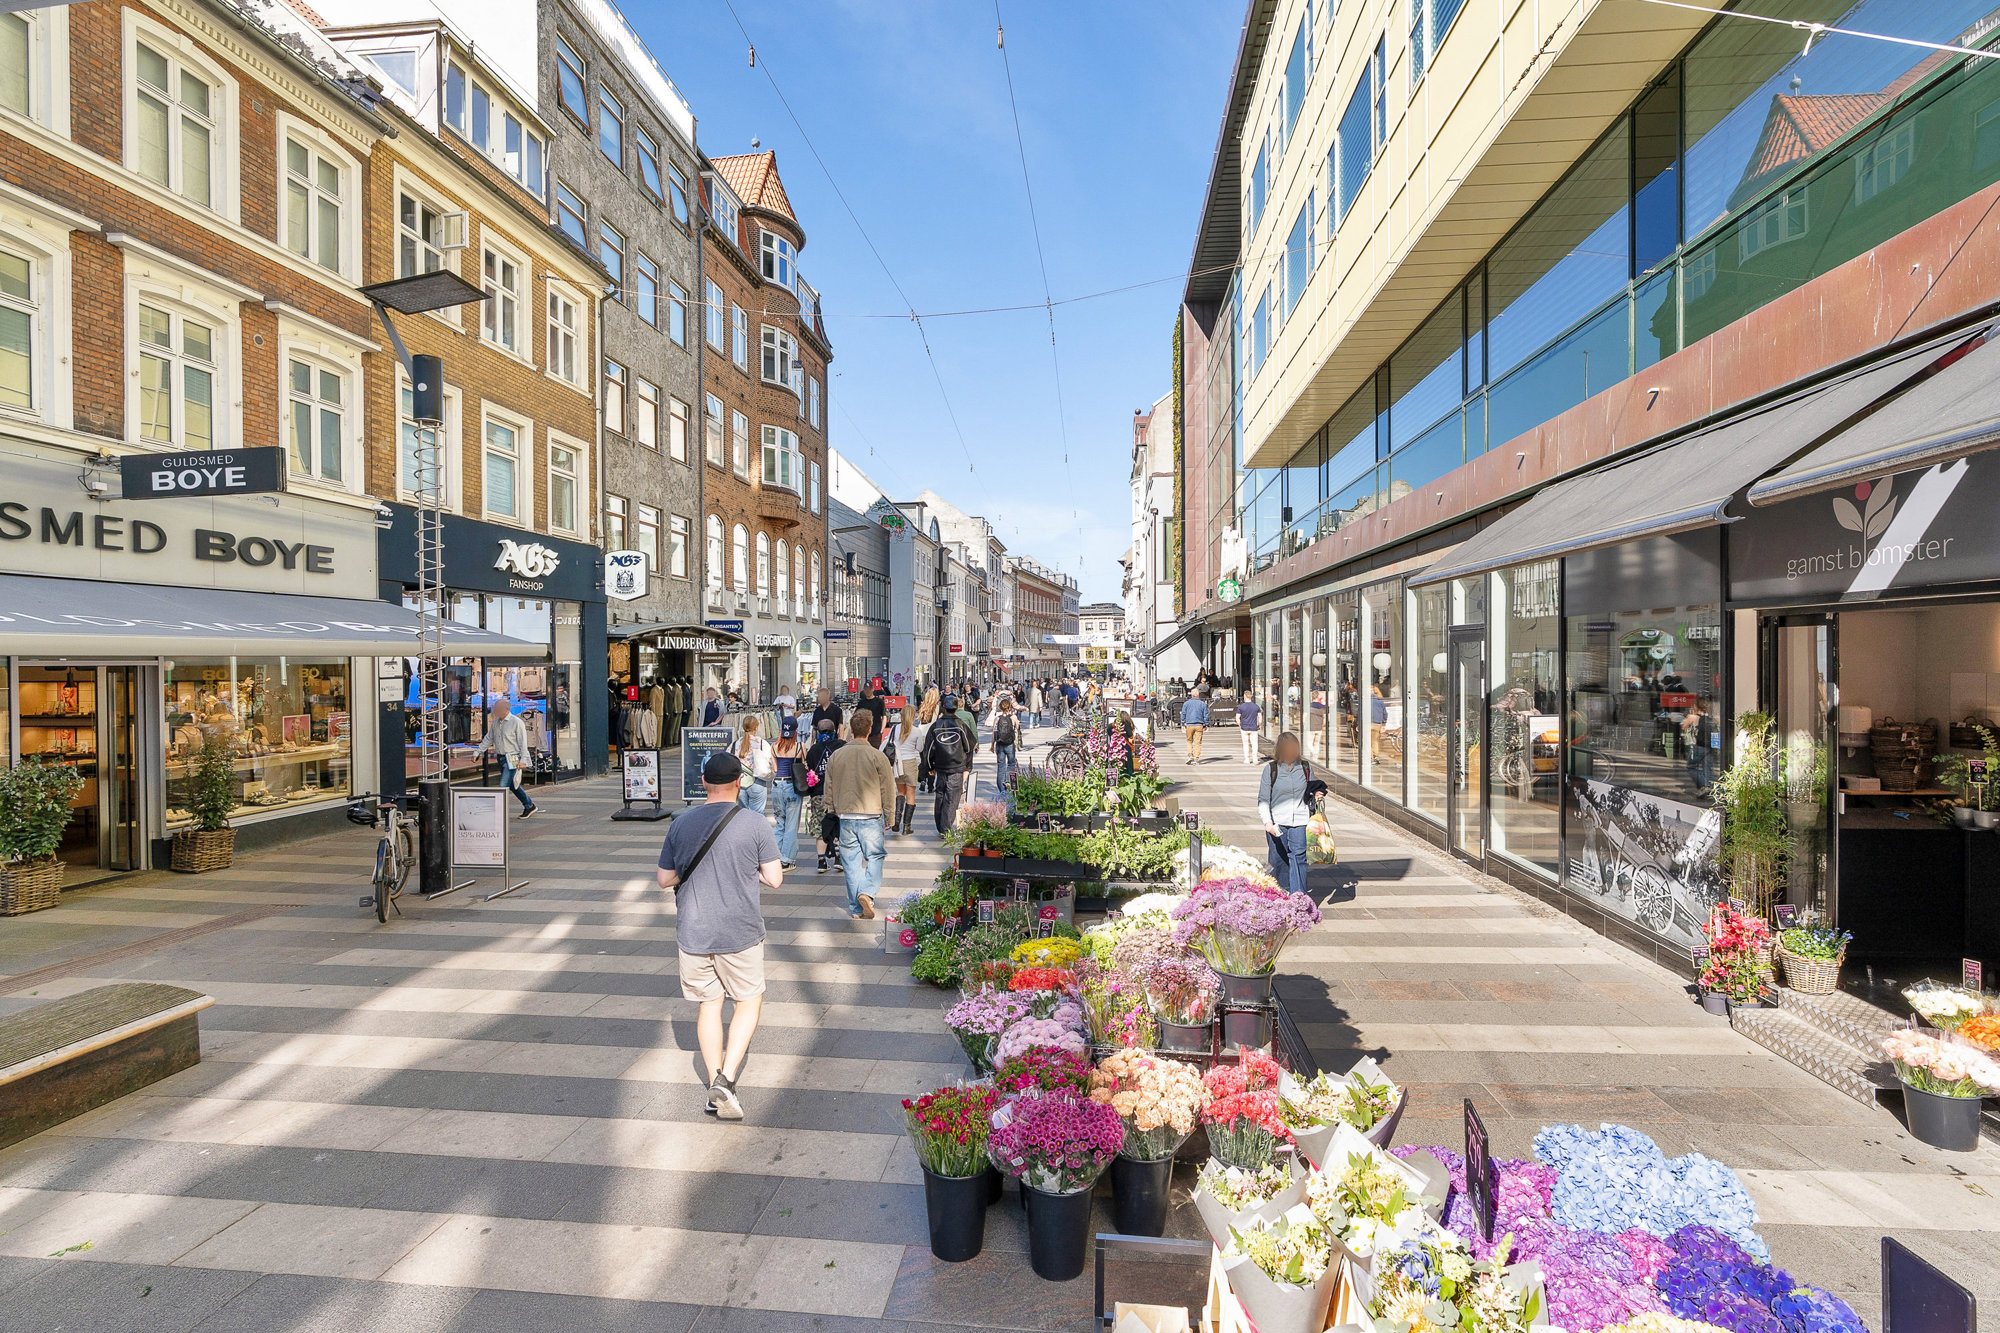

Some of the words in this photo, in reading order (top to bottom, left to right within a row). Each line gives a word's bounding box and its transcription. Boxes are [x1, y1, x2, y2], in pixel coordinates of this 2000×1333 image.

[162, 455, 234, 467] GULDSMED
[151, 466, 247, 491] BOYE
[195, 528, 335, 574] BOYE
[1786, 548, 1844, 581] gamst
[1849, 537, 1954, 569] blomster
[509, 579, 544, 591] FANSHOP
[657, 636, 716, 650] LINDBERGH
[755, 635, 792, 648] ELGIGANTEN
[387, 703, 398, 711] 34
